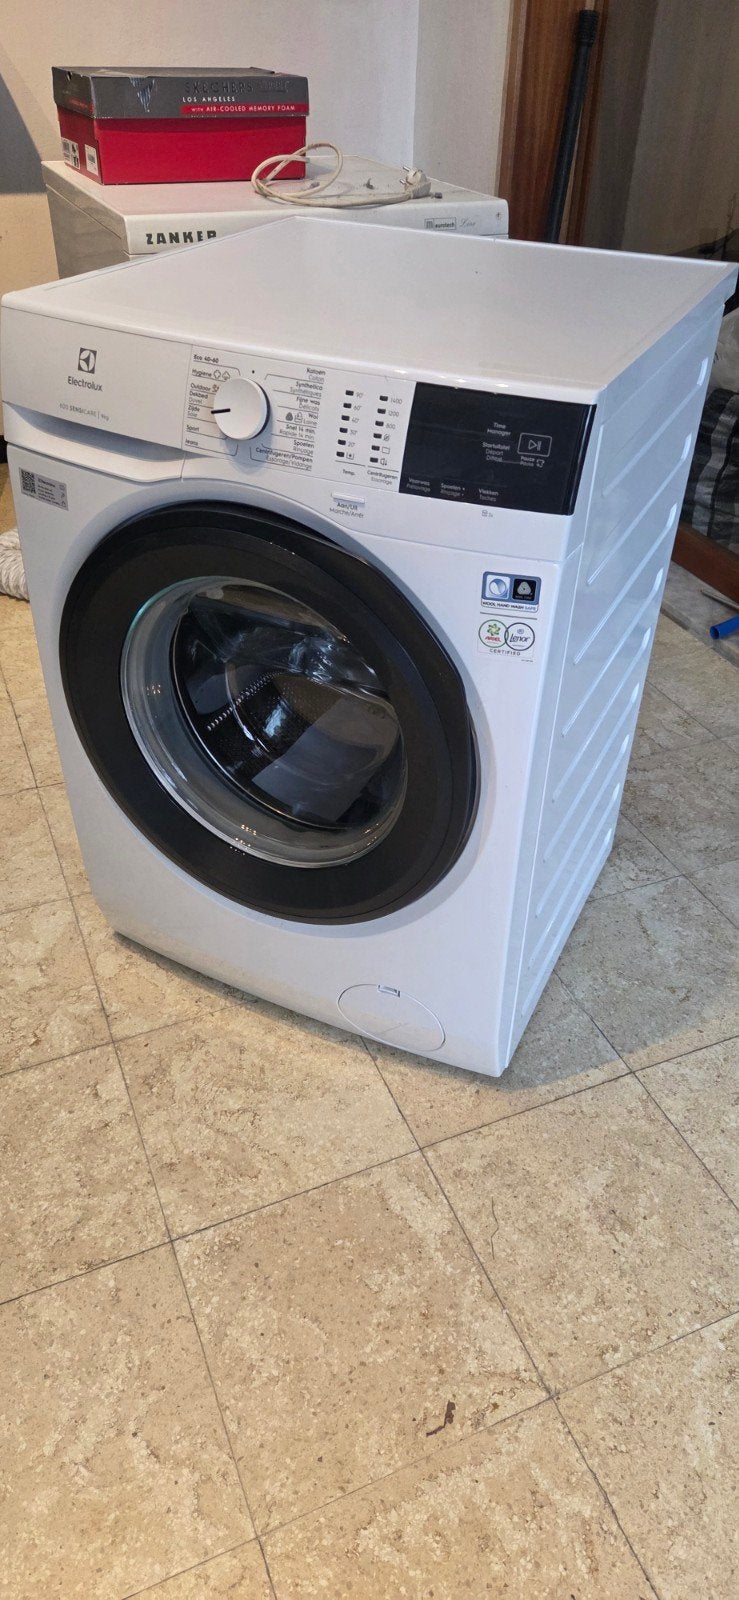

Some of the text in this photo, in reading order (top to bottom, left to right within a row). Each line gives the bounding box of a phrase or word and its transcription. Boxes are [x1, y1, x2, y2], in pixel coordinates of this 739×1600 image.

[184, 80, 254, 94] SKECHERS
[306, 368, 326, 376] Katoen
[68, 376, 103, 392] Electrolux
[190, 383, 211, 391] Outdoor
[189, 391, 209, 399] Dekbed
[390, 397, 403, 405] 1400
[387, 410, 400, 418] 1200
[487, 428, 511, 437] Manager
[293, 440, 315, 449] Spoelen
[408, 477, 430, 486] Voorwas
[440, 483, 461, 491] Spoelen
[478, 488, 499, 496] Vlekken
[509, 633, 528, 643] Lenor
[489, 648, 521, 656] CERTIFIED
